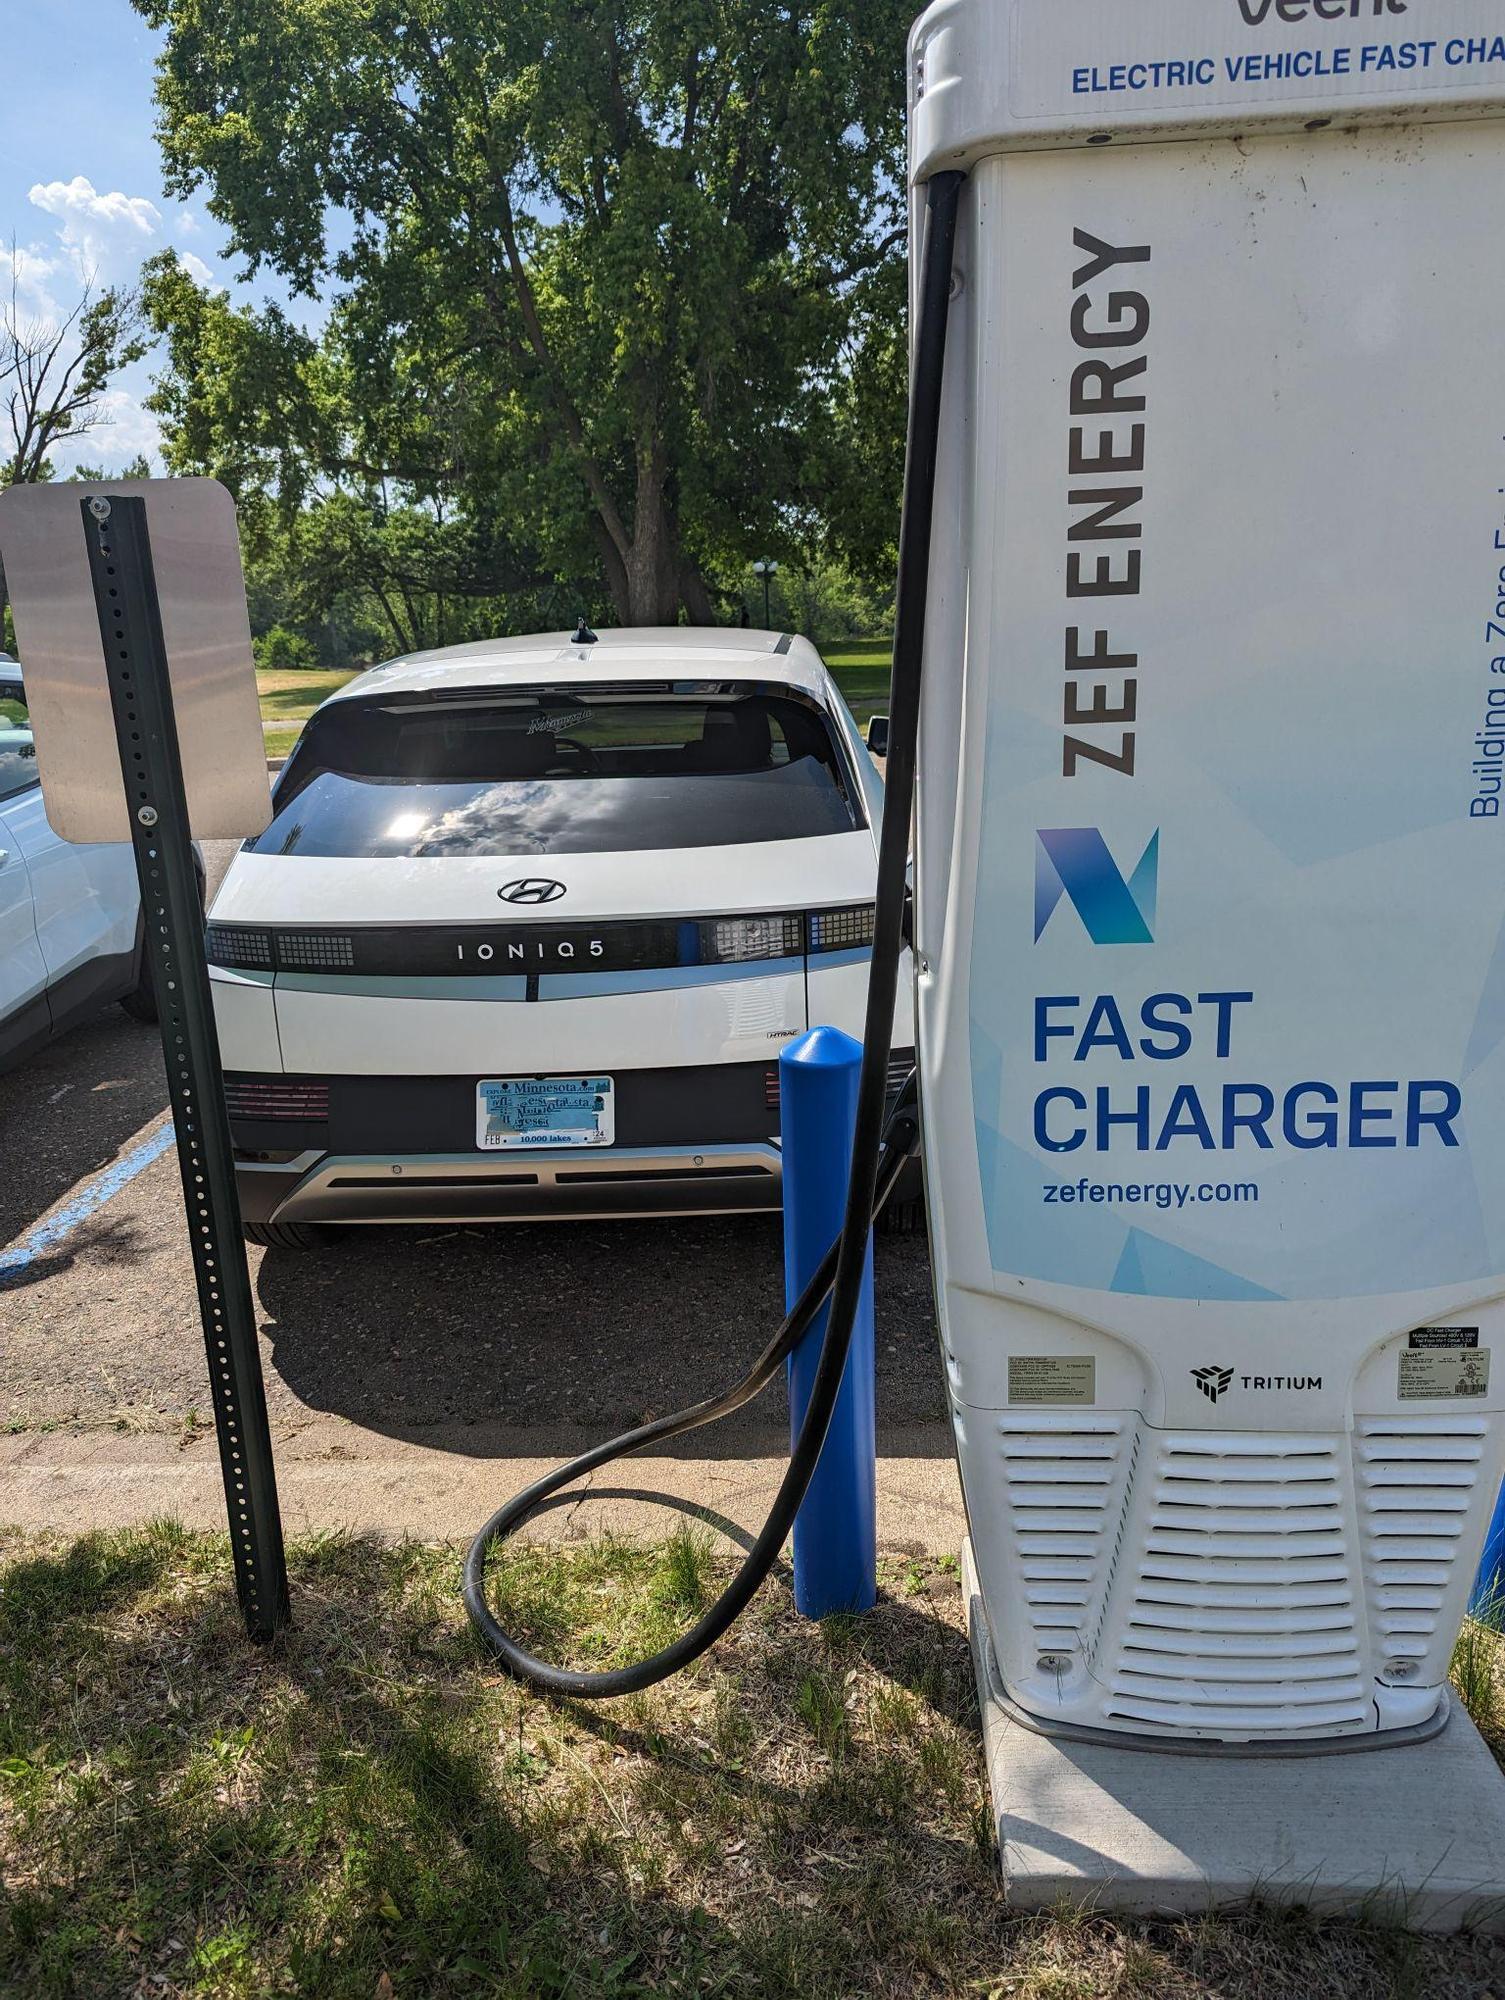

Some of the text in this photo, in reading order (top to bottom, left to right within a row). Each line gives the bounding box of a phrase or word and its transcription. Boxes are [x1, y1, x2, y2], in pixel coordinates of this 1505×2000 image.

[1072, 58, 1215, 93] ELECTRIC
[1224, 48, 1351, 83] VEHICLE
[1360, 41, 1437, 72] FAST
[1063, 226, 1151, 777] ZEF ENERGY
[457, 940, 604, 960] IONIQ 5
[1034, 991, 1254, 1062] FAST
[1033, 1079, 1462, 1153] CHARGER
[485, 1134, 501, 1145] FEB
[520, 1135, 572, 1144] 10,000 lakes
[1042, 1178, 1259, 1209] zefenergy.com
[1240, 1376, 1322, 1390] TRITIUM
